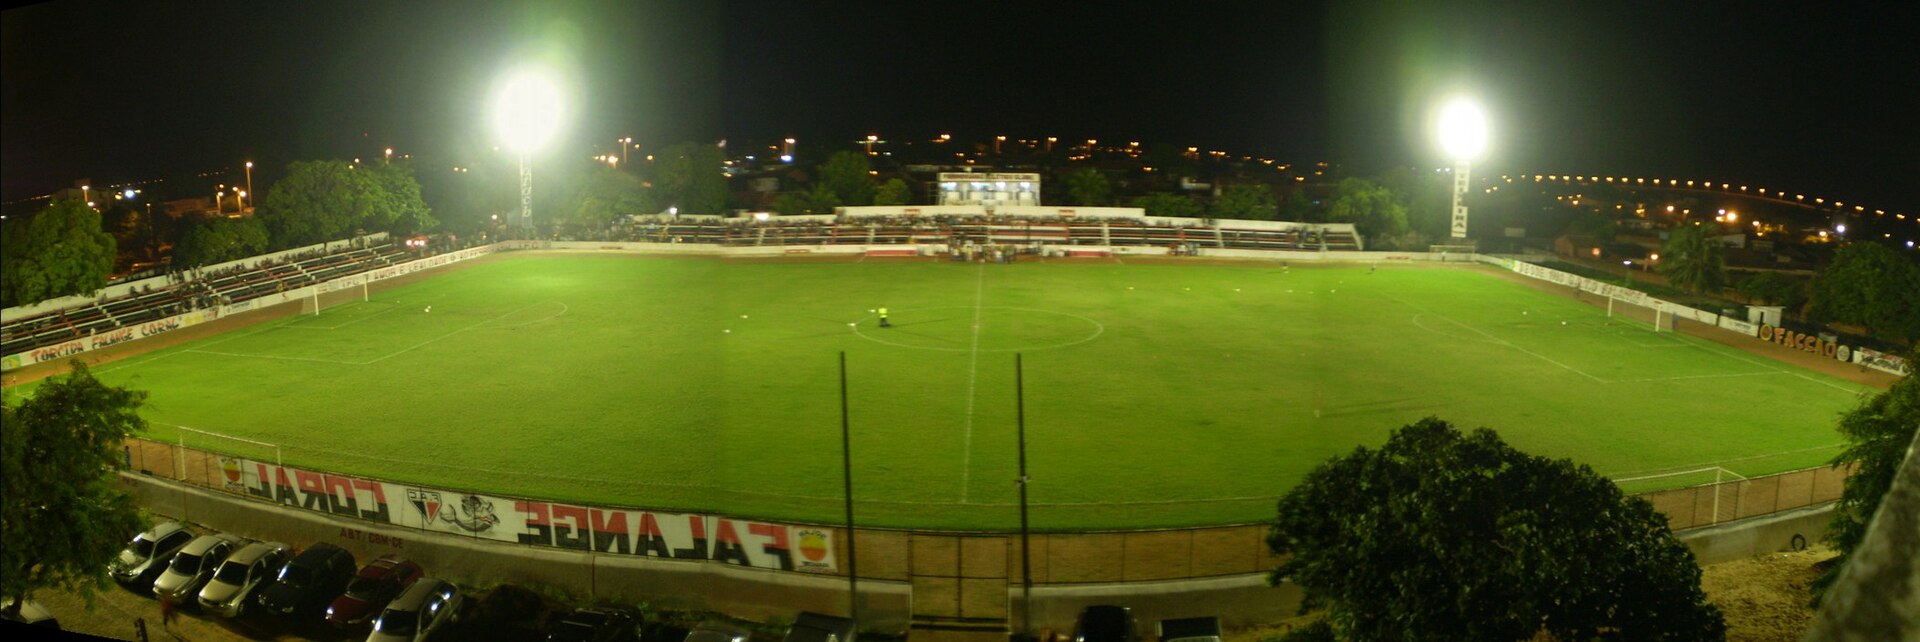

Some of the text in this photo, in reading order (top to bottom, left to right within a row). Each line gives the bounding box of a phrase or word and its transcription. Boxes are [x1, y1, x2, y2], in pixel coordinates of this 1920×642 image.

[374, 268, 396, 280] AMOR
[399, 266, 405, 275] E
[31, 319, 180, 363] TORCIDA FALANGE CORAL
